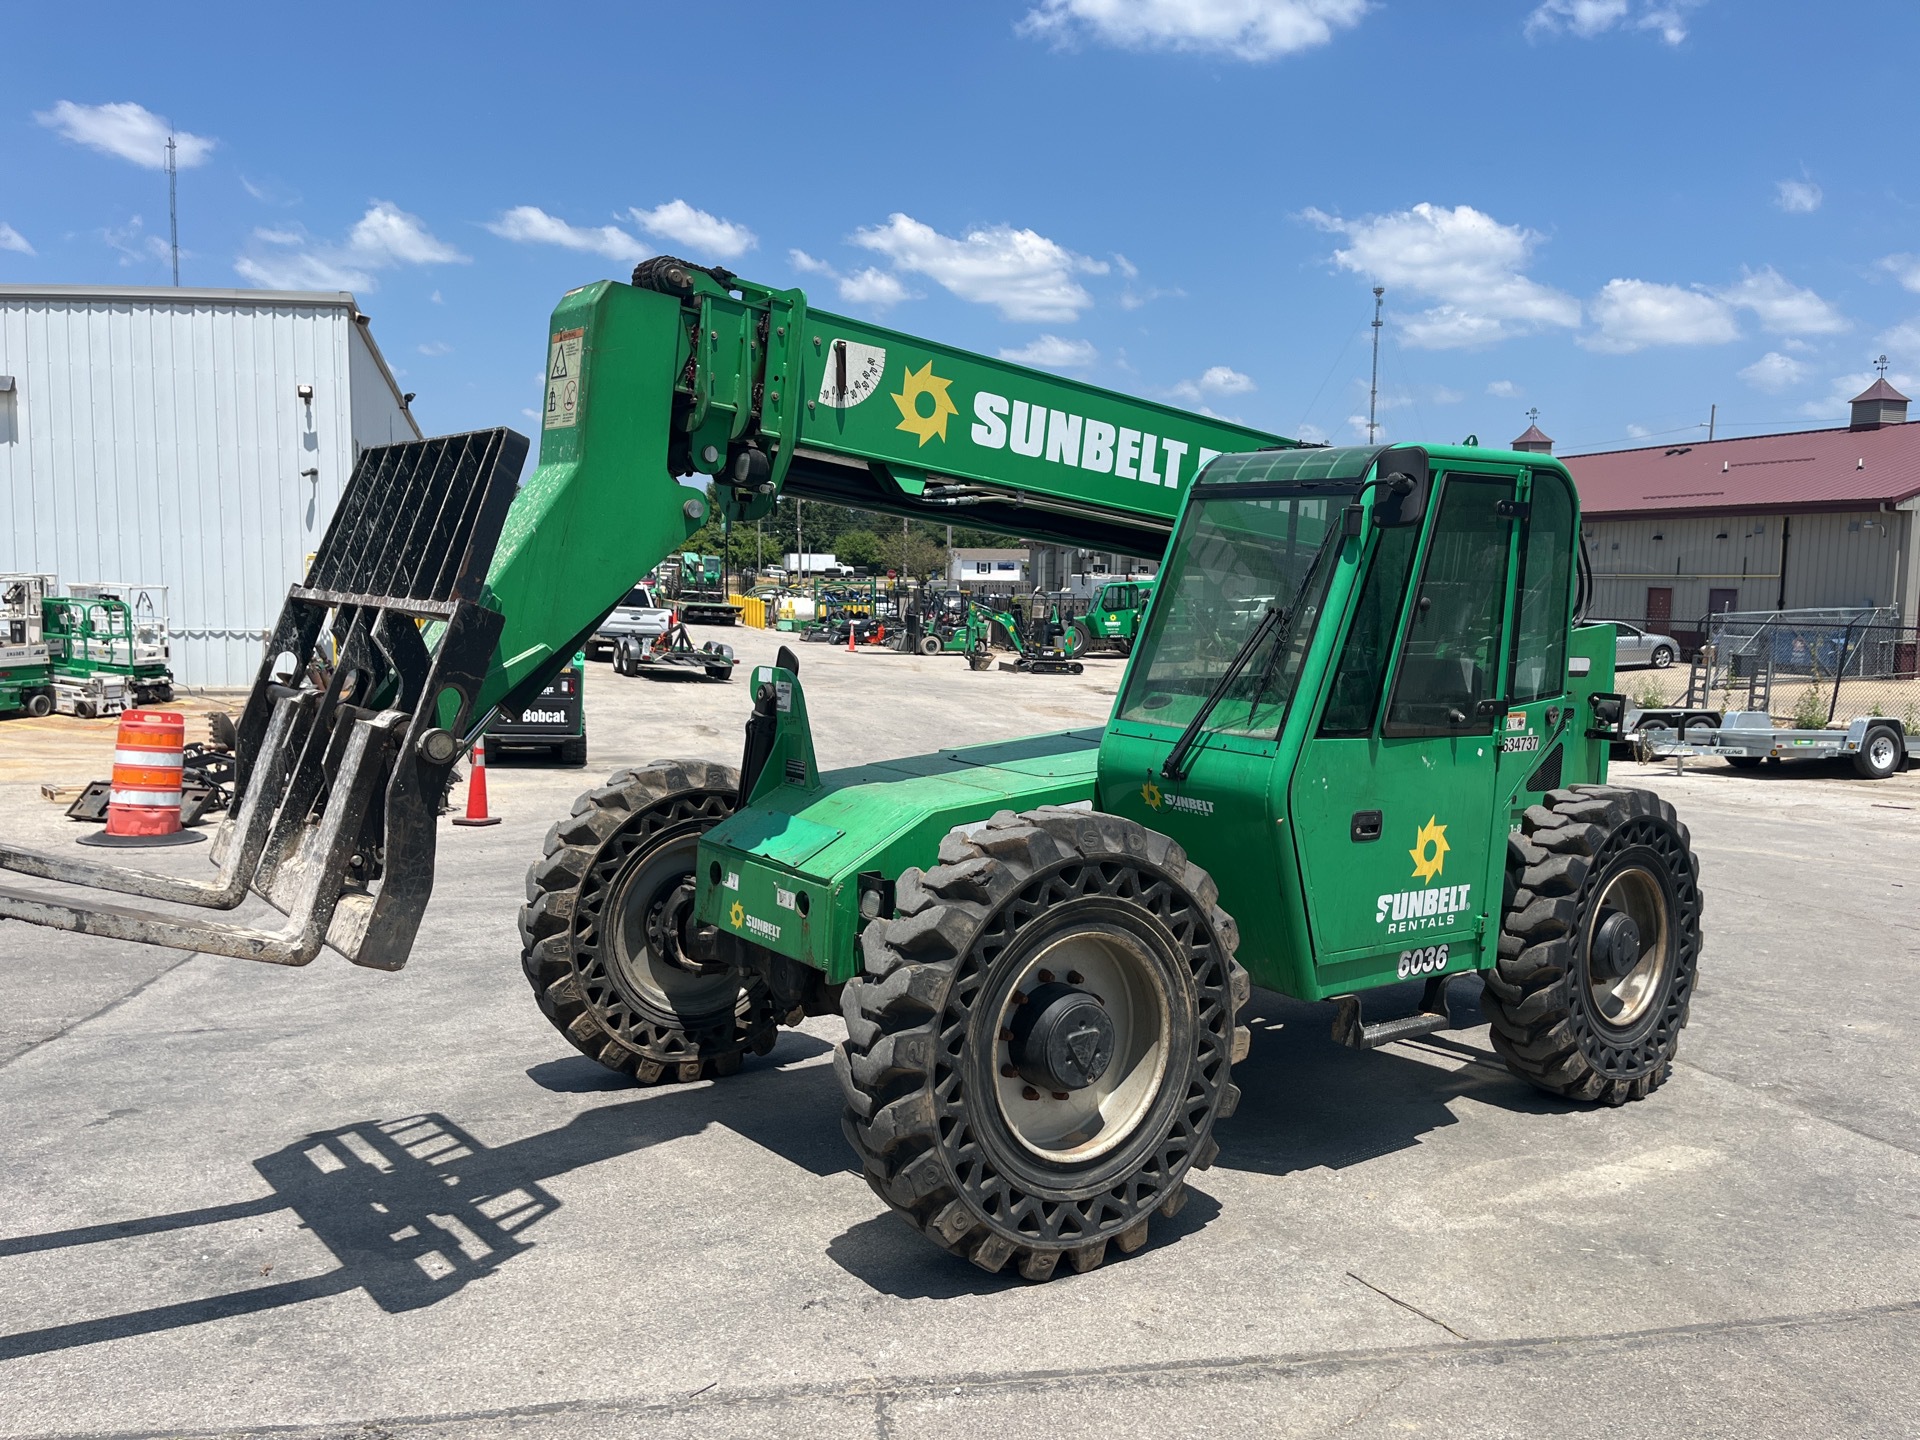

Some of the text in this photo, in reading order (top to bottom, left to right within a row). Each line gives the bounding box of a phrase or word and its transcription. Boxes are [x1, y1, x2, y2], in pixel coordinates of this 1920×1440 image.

[970, 391, 1189, 489] SUNBELT
[522, 709, 565, 723] Bobcat
[1164, 793, 1214, 813] SUNBELT
[1173, 806, 1209, 817] RENTALS
[1376, 884, 1471, 923] SUNBELT
[745, 914, 781, 939] SUNBELT
[750, 928, 776, 942] RENTALS
[1387, 914, 1455, 935] RENTALS
[1397, 944, 1449, 980] 6036
